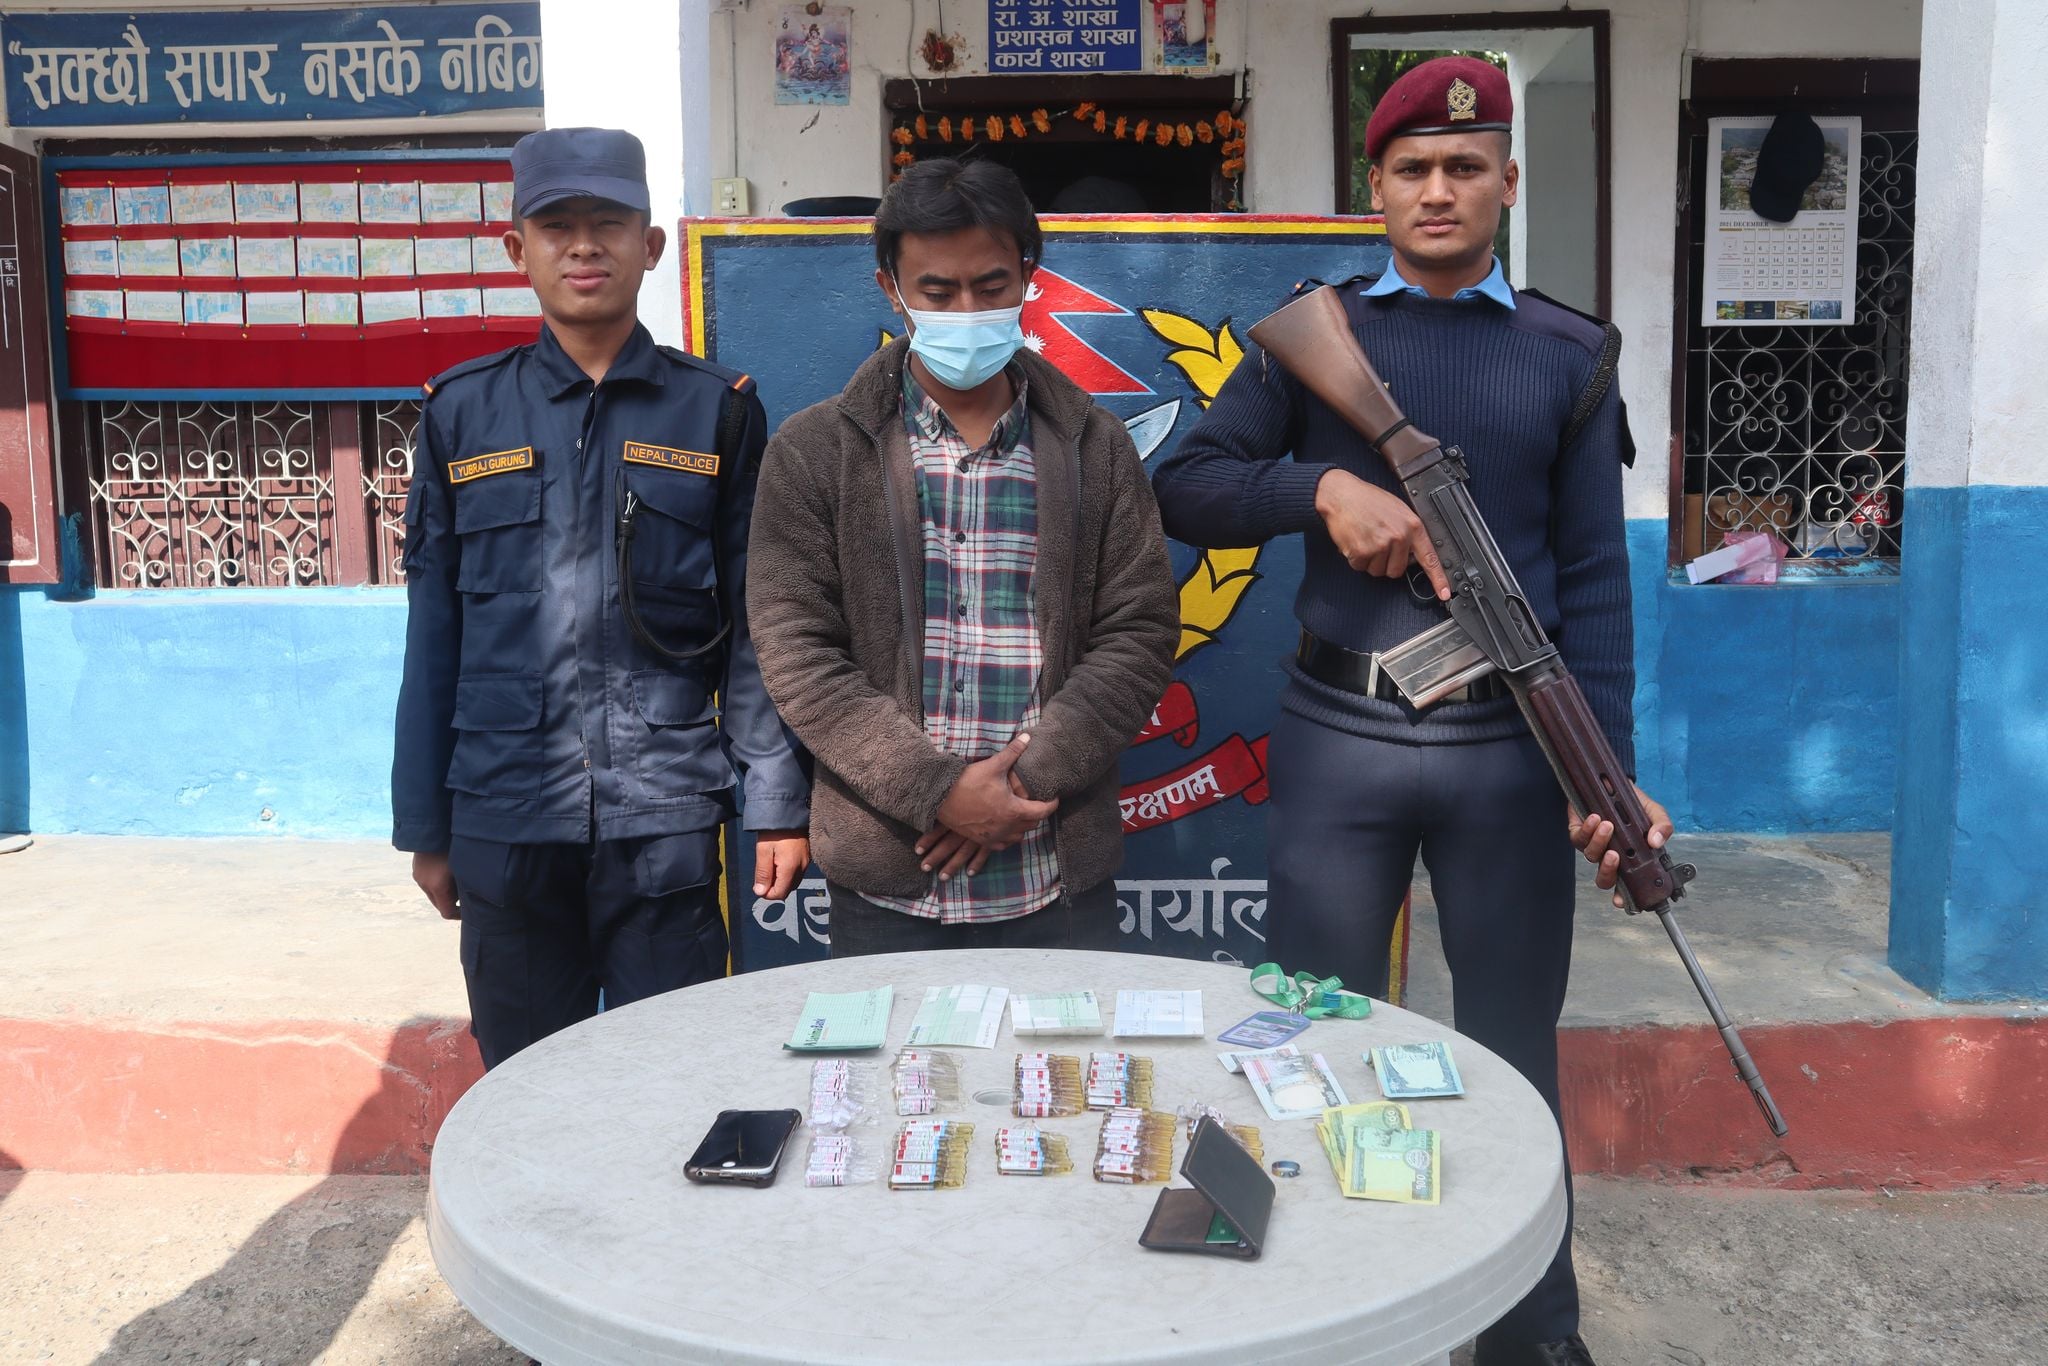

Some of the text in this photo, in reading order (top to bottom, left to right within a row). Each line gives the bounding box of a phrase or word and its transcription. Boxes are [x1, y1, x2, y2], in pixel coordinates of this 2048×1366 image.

[1029, 10, 1055, 27] अ.
[1062, 9, 1119, 27] शाखा
[995, 29, 1137, 47] प्रशासन शाखा
[164, 43, 287, 108] सपार,
[301, 19, 424, 103] नसके
[437, 14, 544, 94] नबिग
[995, 48, 1106, 68] कार्य शाखा
[457, 453, 526, 478] YUBRAJ GURUNG
[629, 446, 713, 470] NEPAL POLICE
[1118, 763, 1226, 828] रक्षणम्
[752, 856, 1269, 945] वड ार्याल
